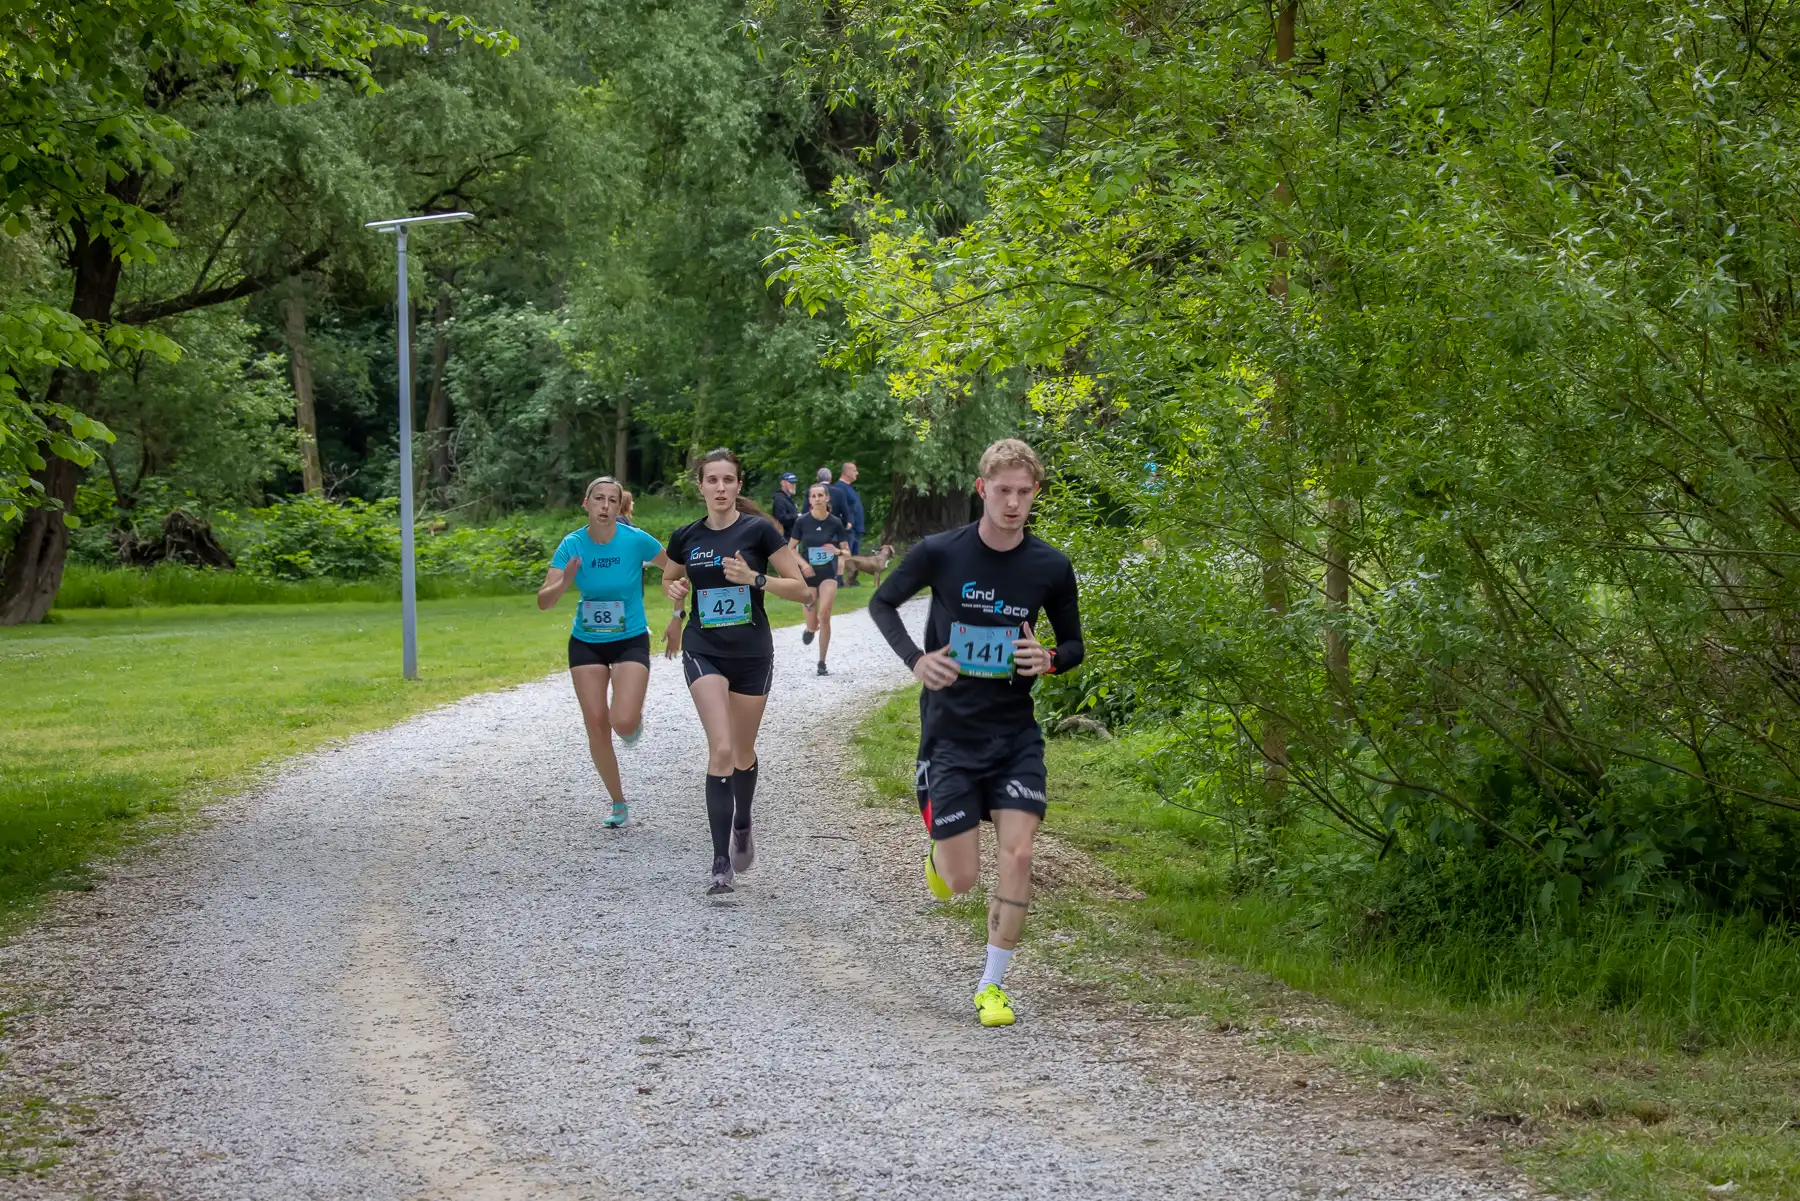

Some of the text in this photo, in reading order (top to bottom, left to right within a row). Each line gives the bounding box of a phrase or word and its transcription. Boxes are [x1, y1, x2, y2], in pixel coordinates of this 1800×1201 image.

[690, 547, 714, 560] Fund
[816, 552, 827, 560] 33
[961, 581, 995, 600] Fund
[713, 598, 736, 615] 42
[994, 600, 1029, 617] Race
[594, 611, 612, 623] 68
[964, 641, 1003, 663] 141
